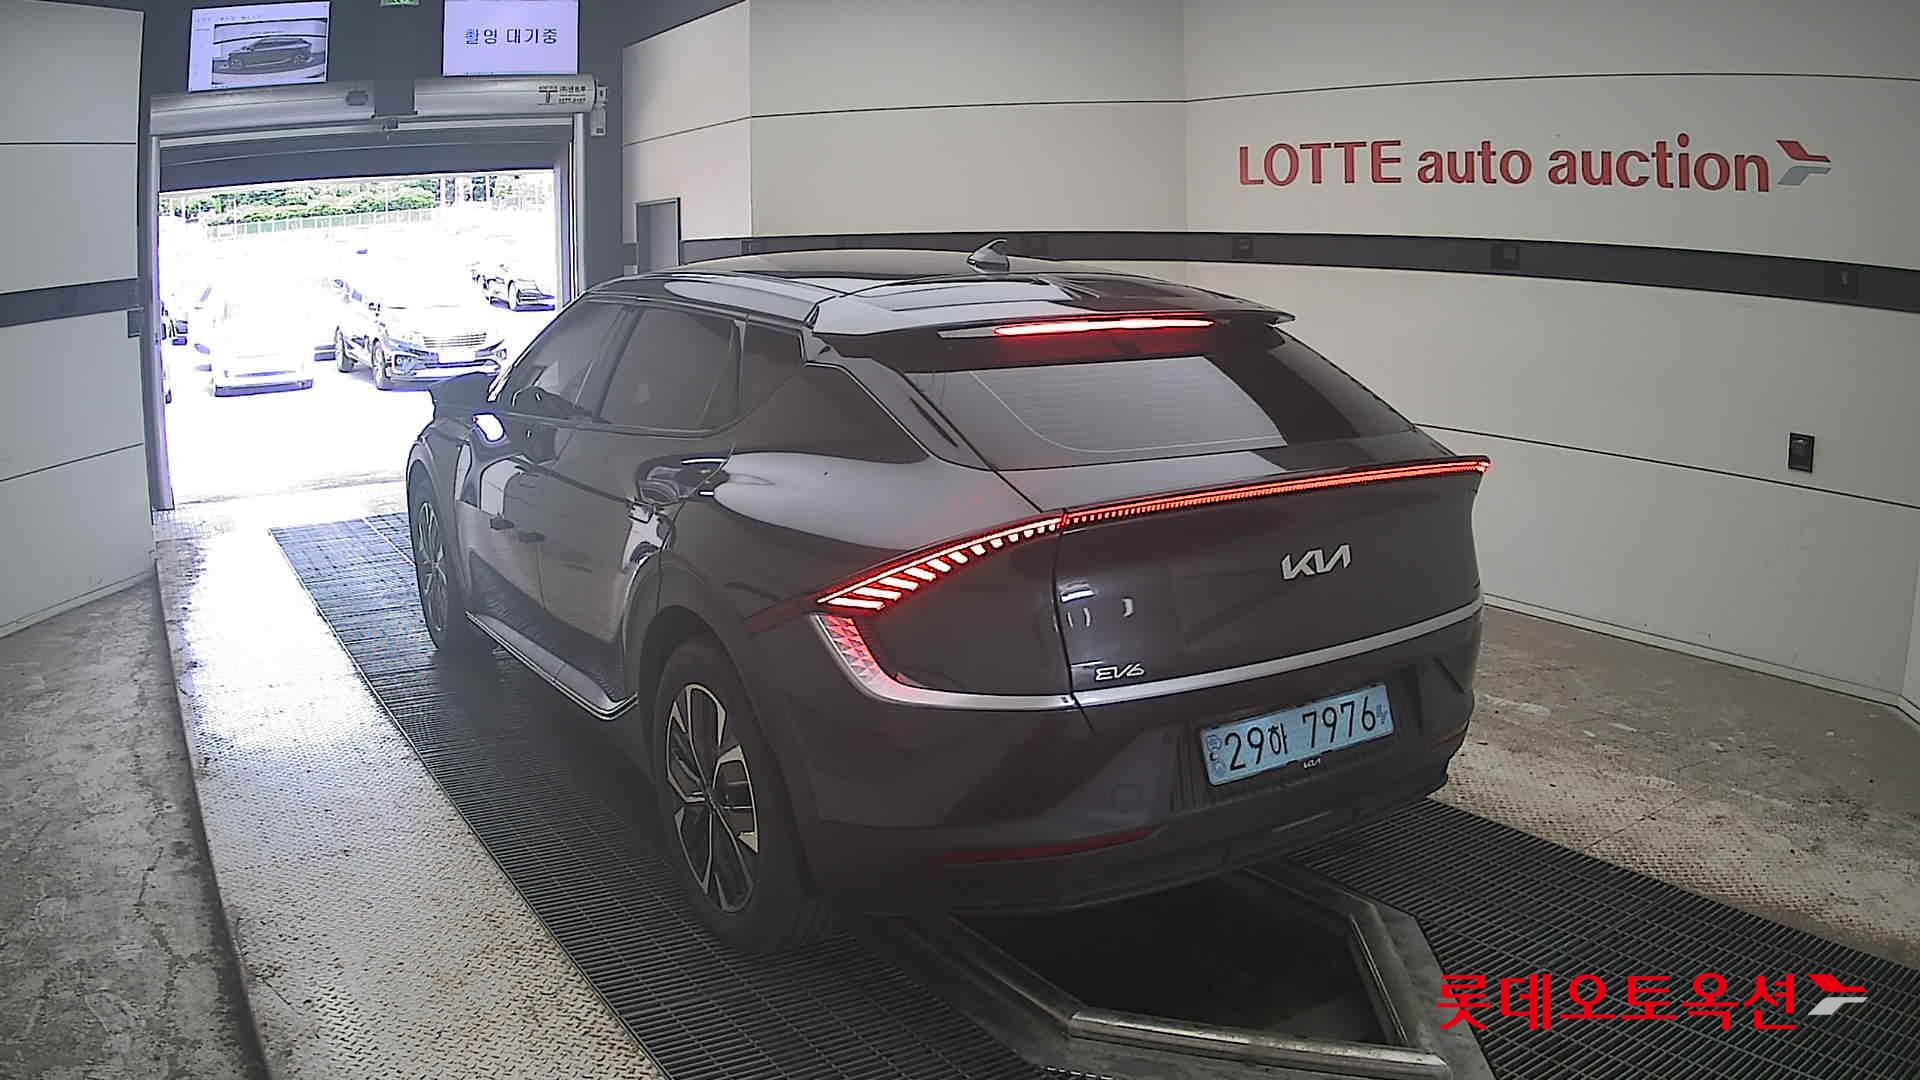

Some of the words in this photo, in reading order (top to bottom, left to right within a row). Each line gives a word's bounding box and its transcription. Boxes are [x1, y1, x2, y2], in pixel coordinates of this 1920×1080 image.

[506, 28, 558, 45] 대기중
[1239, 140, 1401, 186] LOTTE
[1417, 140, 1532, 184] auto
[1548, 133, 1770, 192] auction
[1095, 663, 1145, 681] EV6
[1224, 722, 1288, 771] 29하
[1302, 696, 1376, 749] 7976
